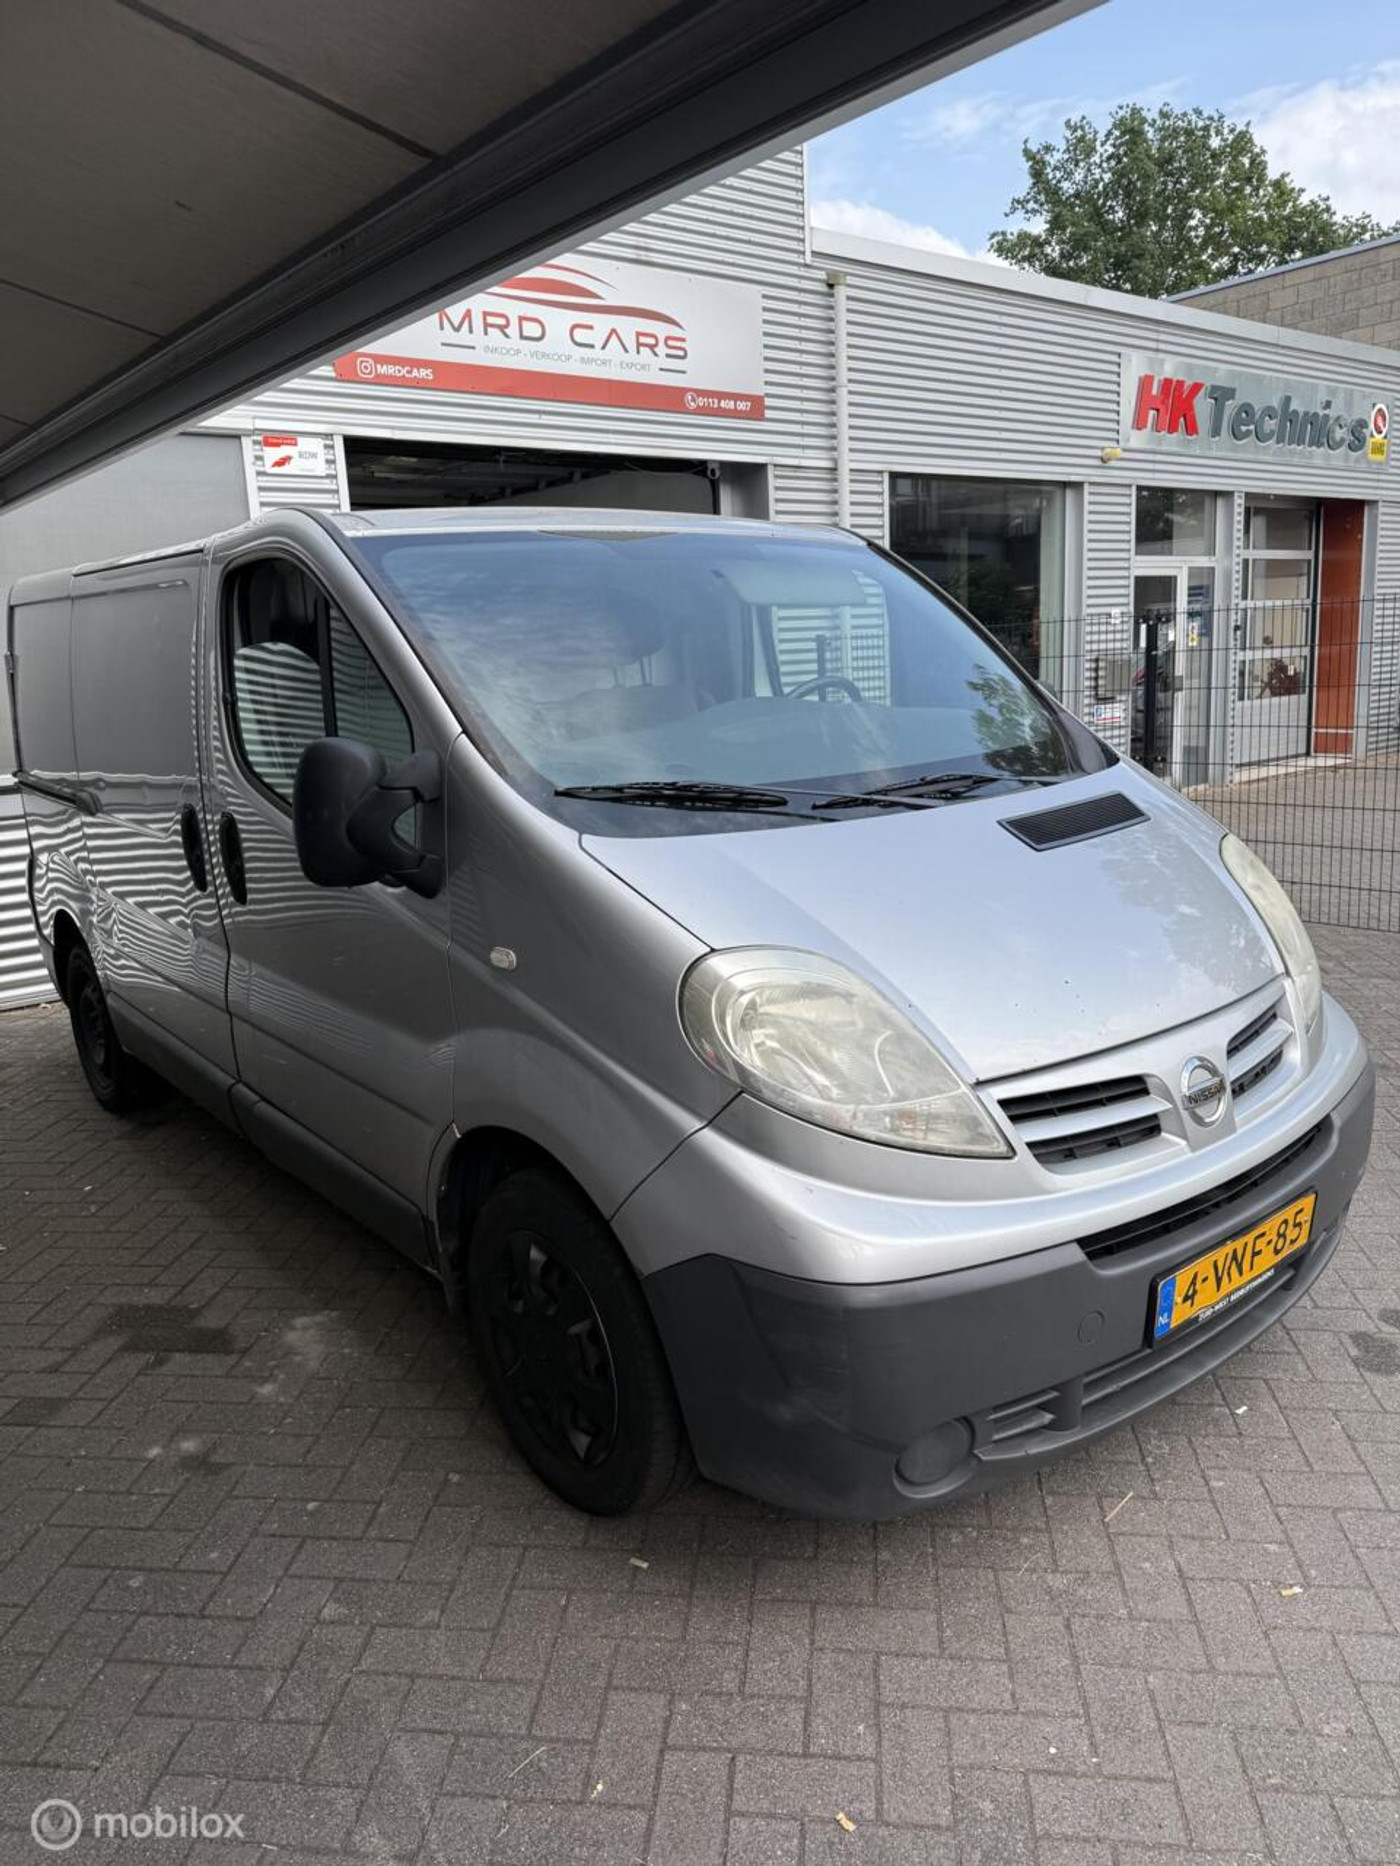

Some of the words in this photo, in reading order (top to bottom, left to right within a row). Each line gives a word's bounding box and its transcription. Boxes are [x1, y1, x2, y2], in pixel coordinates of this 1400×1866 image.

[438, 307, 547, 343] MRD
[569, 322, 689, 361] CARS
[376, 363, 434, 380] MRDCARS
[483, 345, 522, 358] INKOOP
[529, 350, 573, 363] VERKOOP
[580, 357, 613, 368] IMPORT
[619, 361, 652, 373] EXPORT
[698, 396, 719, 409] 0113
[736, 400, 752, 412] 007
[1132, 374, 1205, 437] HK
[1208, 384, 1369, 454] Technics
[1182, 1207, 1305, 1308] 4-VNF-85
[1157, 1313, 1170, 1327] NL
